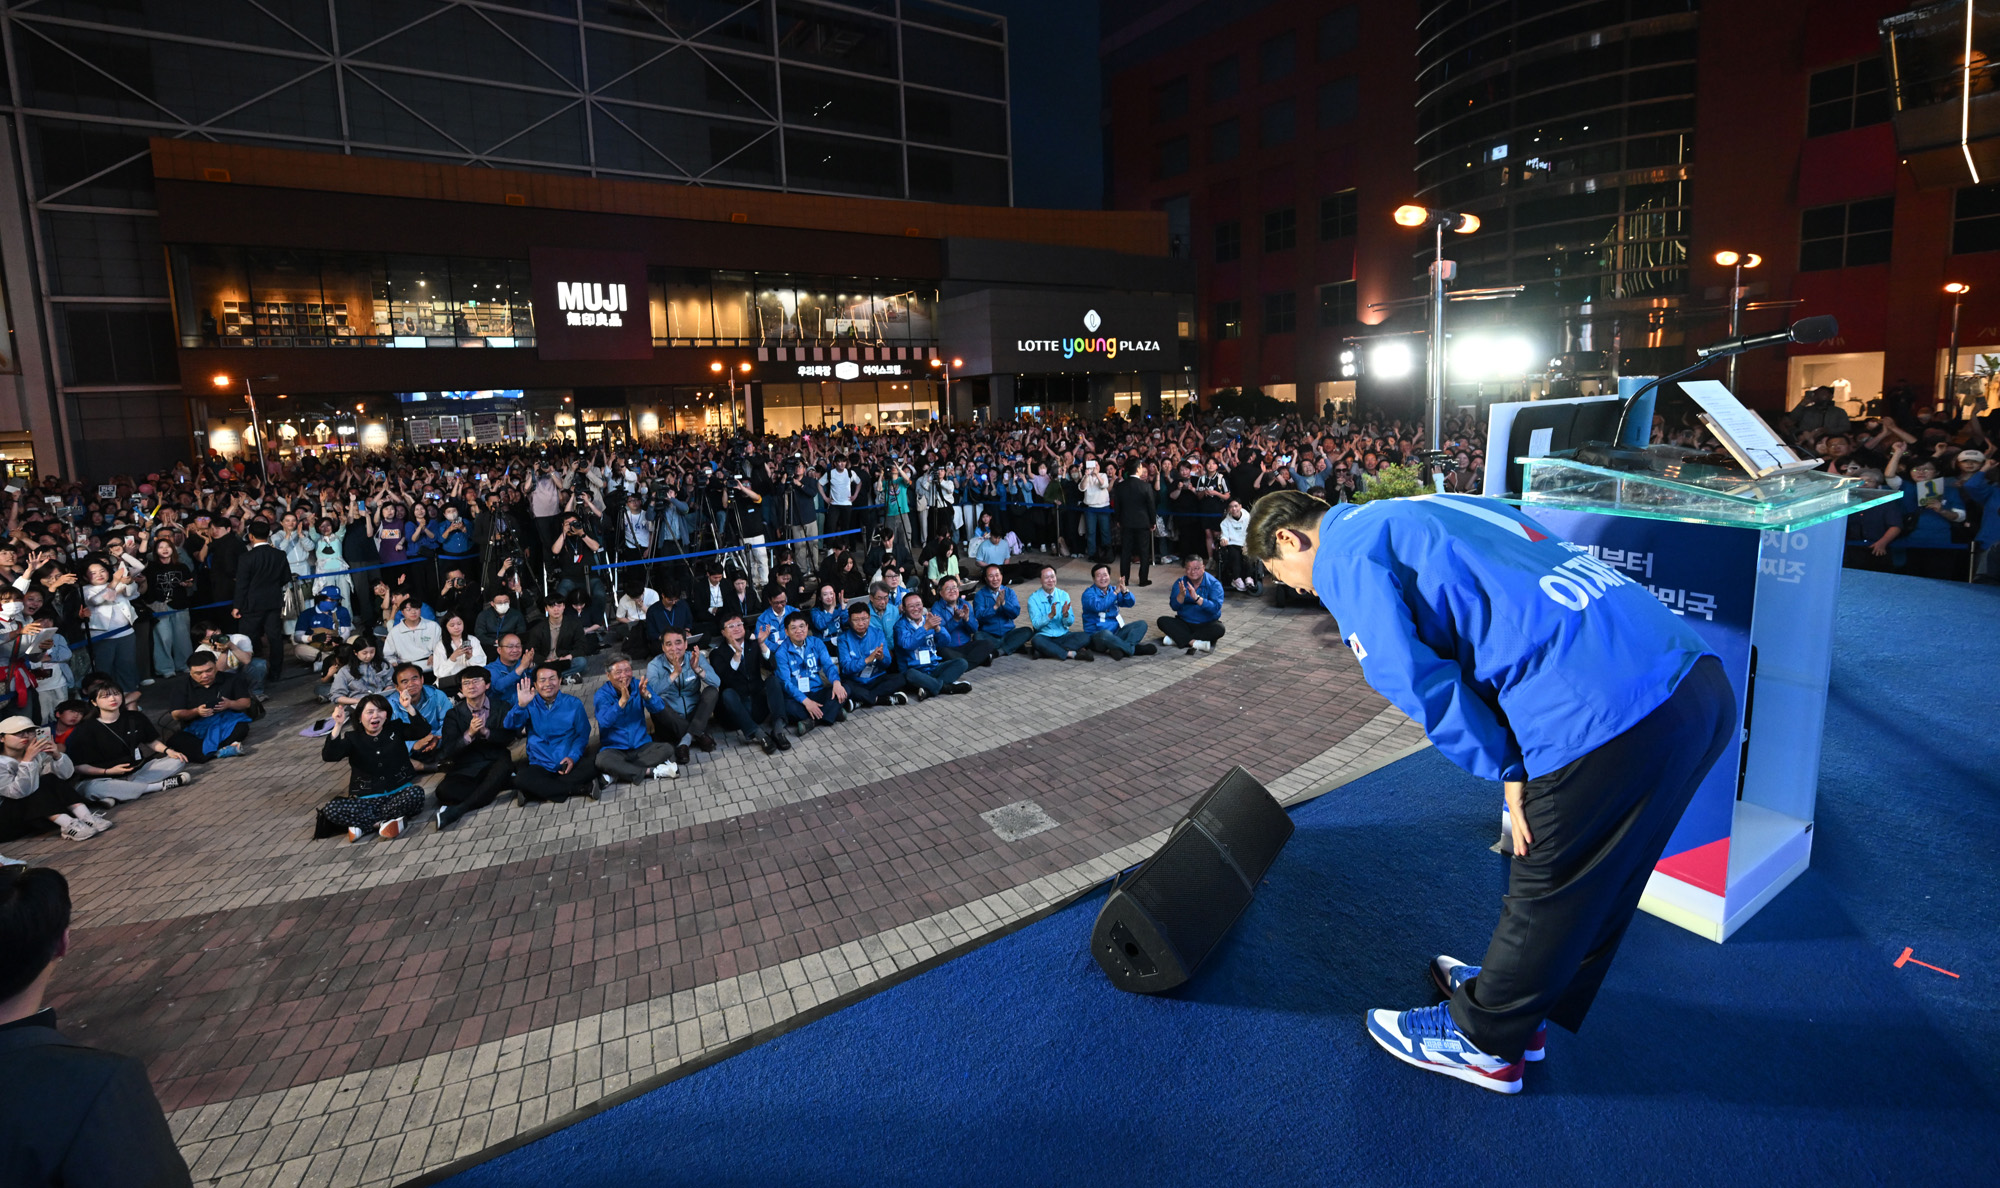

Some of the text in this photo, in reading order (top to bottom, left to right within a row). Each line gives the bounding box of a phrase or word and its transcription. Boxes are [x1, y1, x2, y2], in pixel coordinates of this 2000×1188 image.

[557, 281, 628, 312] MUJI
[566, 311, 623, 327] 無印良品
[1017, 337, 1160, 359] LOTTE young PLAZA
[1924, 480, 1939, 498] 1
[1538, 554, 1636, 612] 이재
